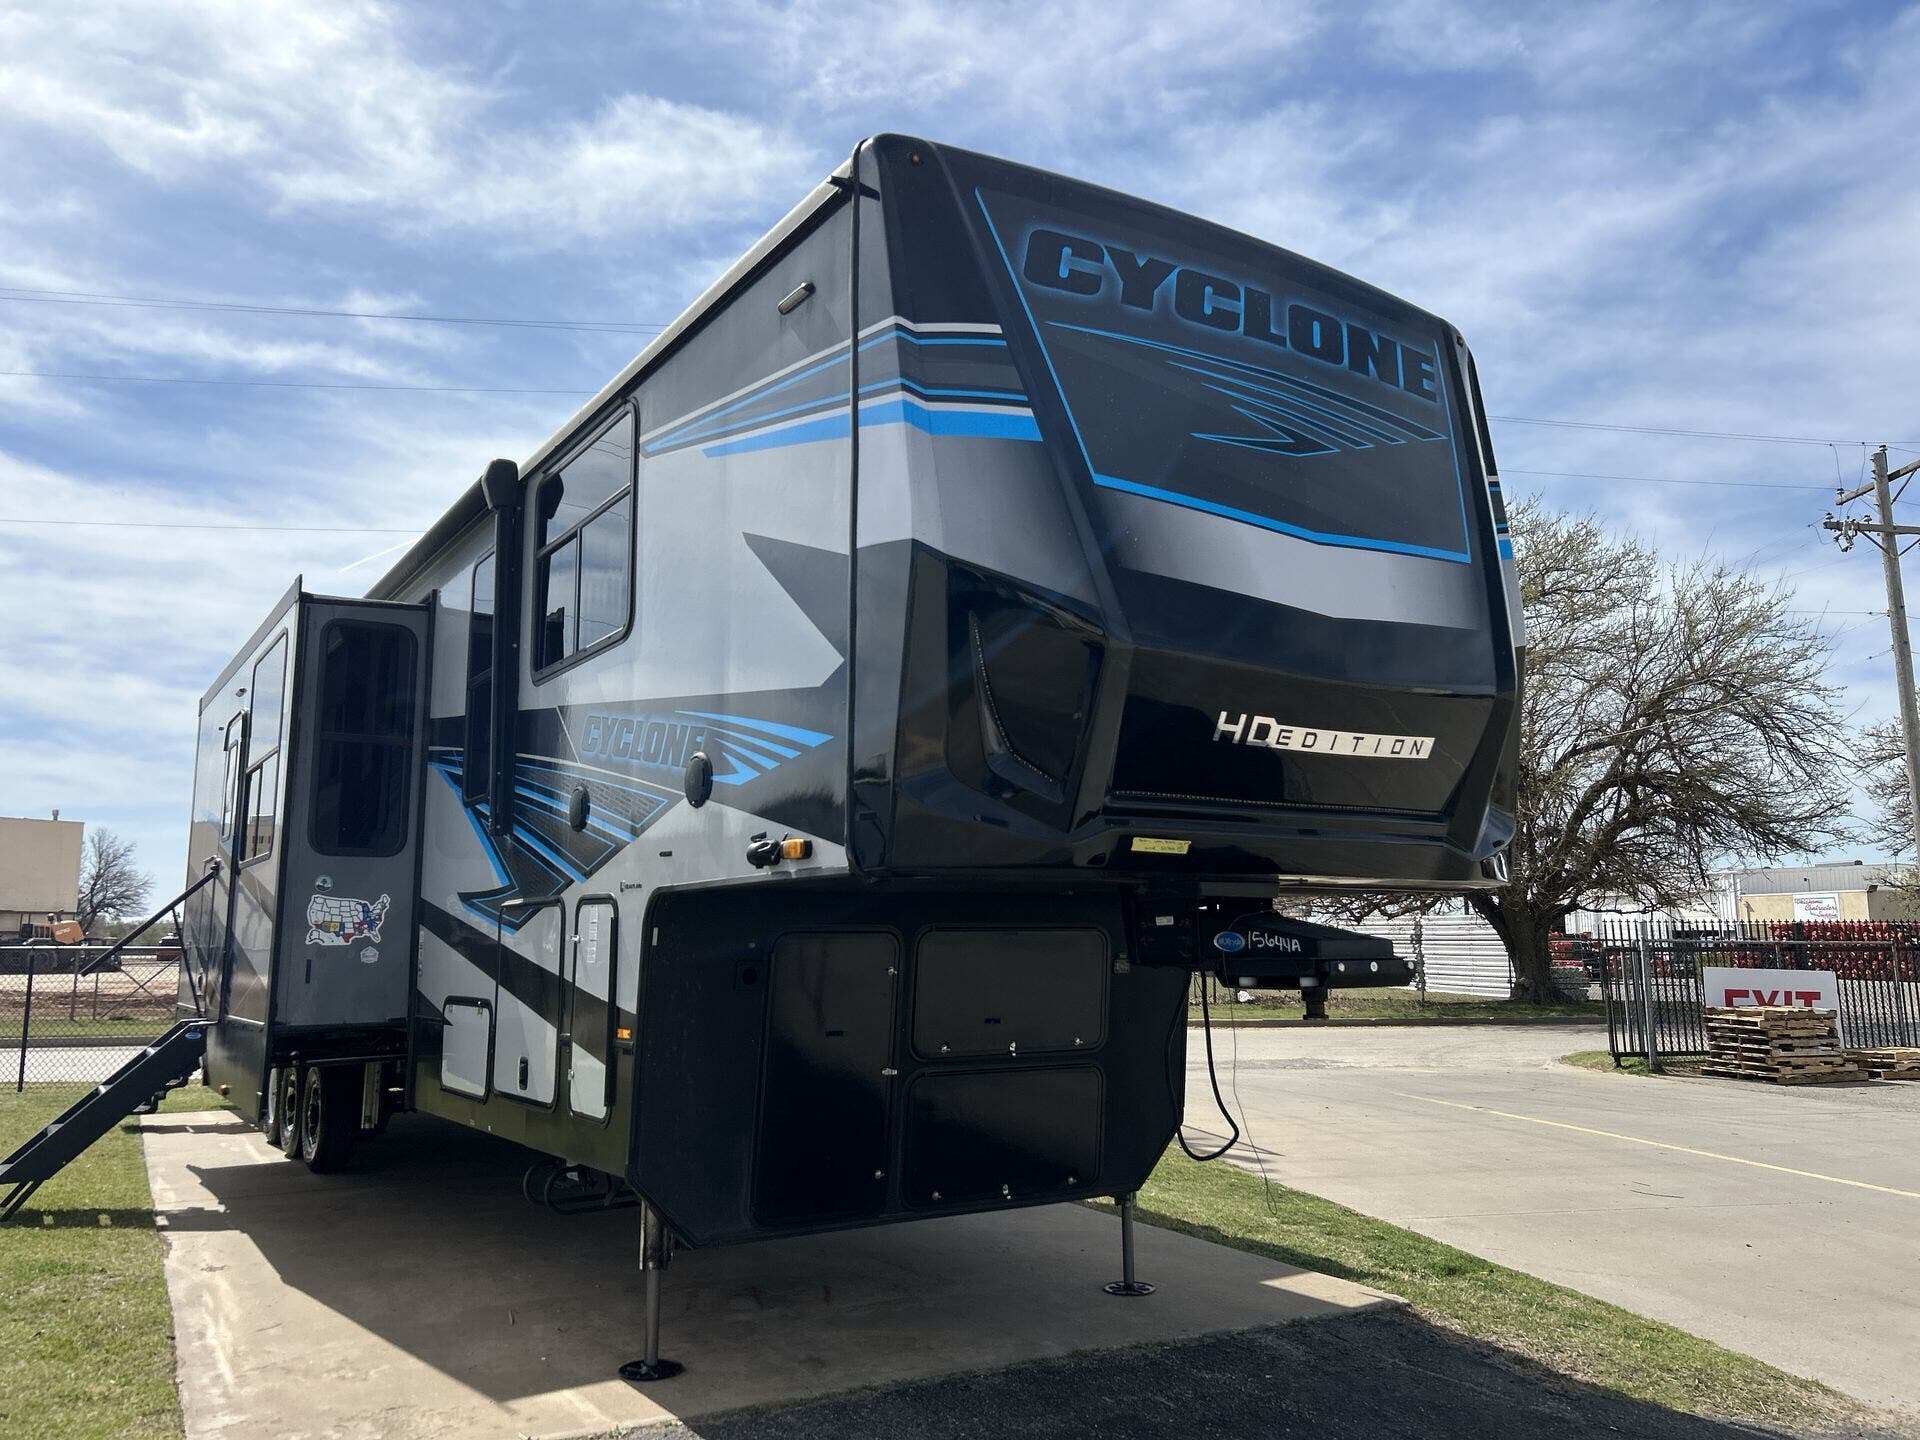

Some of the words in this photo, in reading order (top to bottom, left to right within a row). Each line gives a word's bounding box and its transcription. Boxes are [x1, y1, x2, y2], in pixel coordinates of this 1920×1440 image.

[1023, 229, 1438, 403] CYCLONE
[581, 715, 706, 768] CYCLONE
[1212, 711, 1275, 747] HD
[1275, 728, 1425, 757] EDITION
[1248, 931, 1301, 952] 15644A
